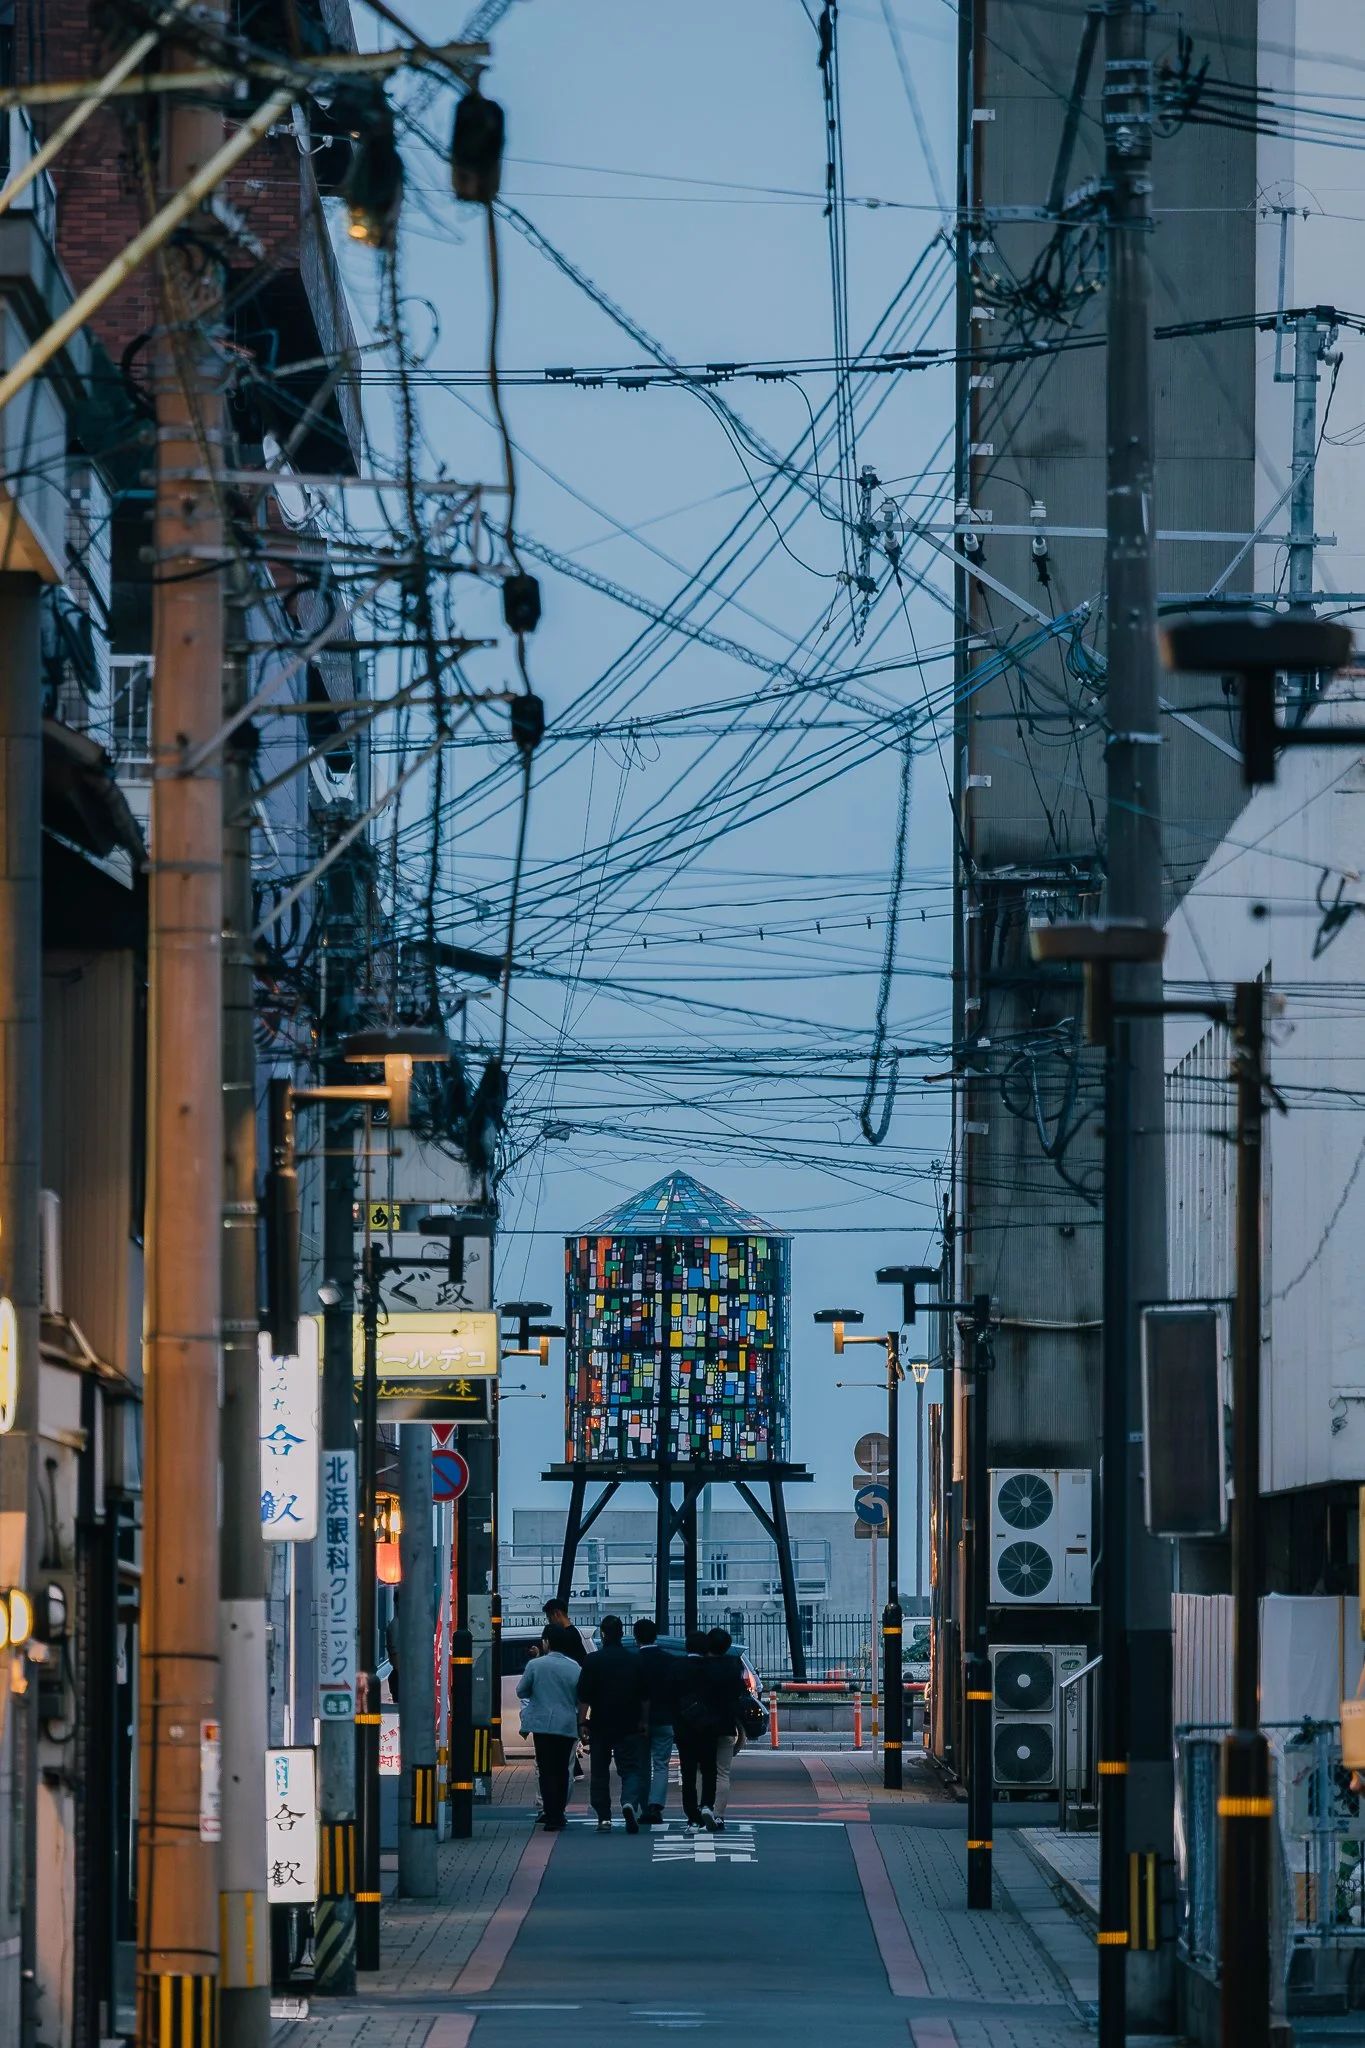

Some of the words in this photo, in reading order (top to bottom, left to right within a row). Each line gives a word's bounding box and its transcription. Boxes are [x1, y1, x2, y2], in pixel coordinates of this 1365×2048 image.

[325, 1456, 350, 1677] 北浜眼科クリニック
